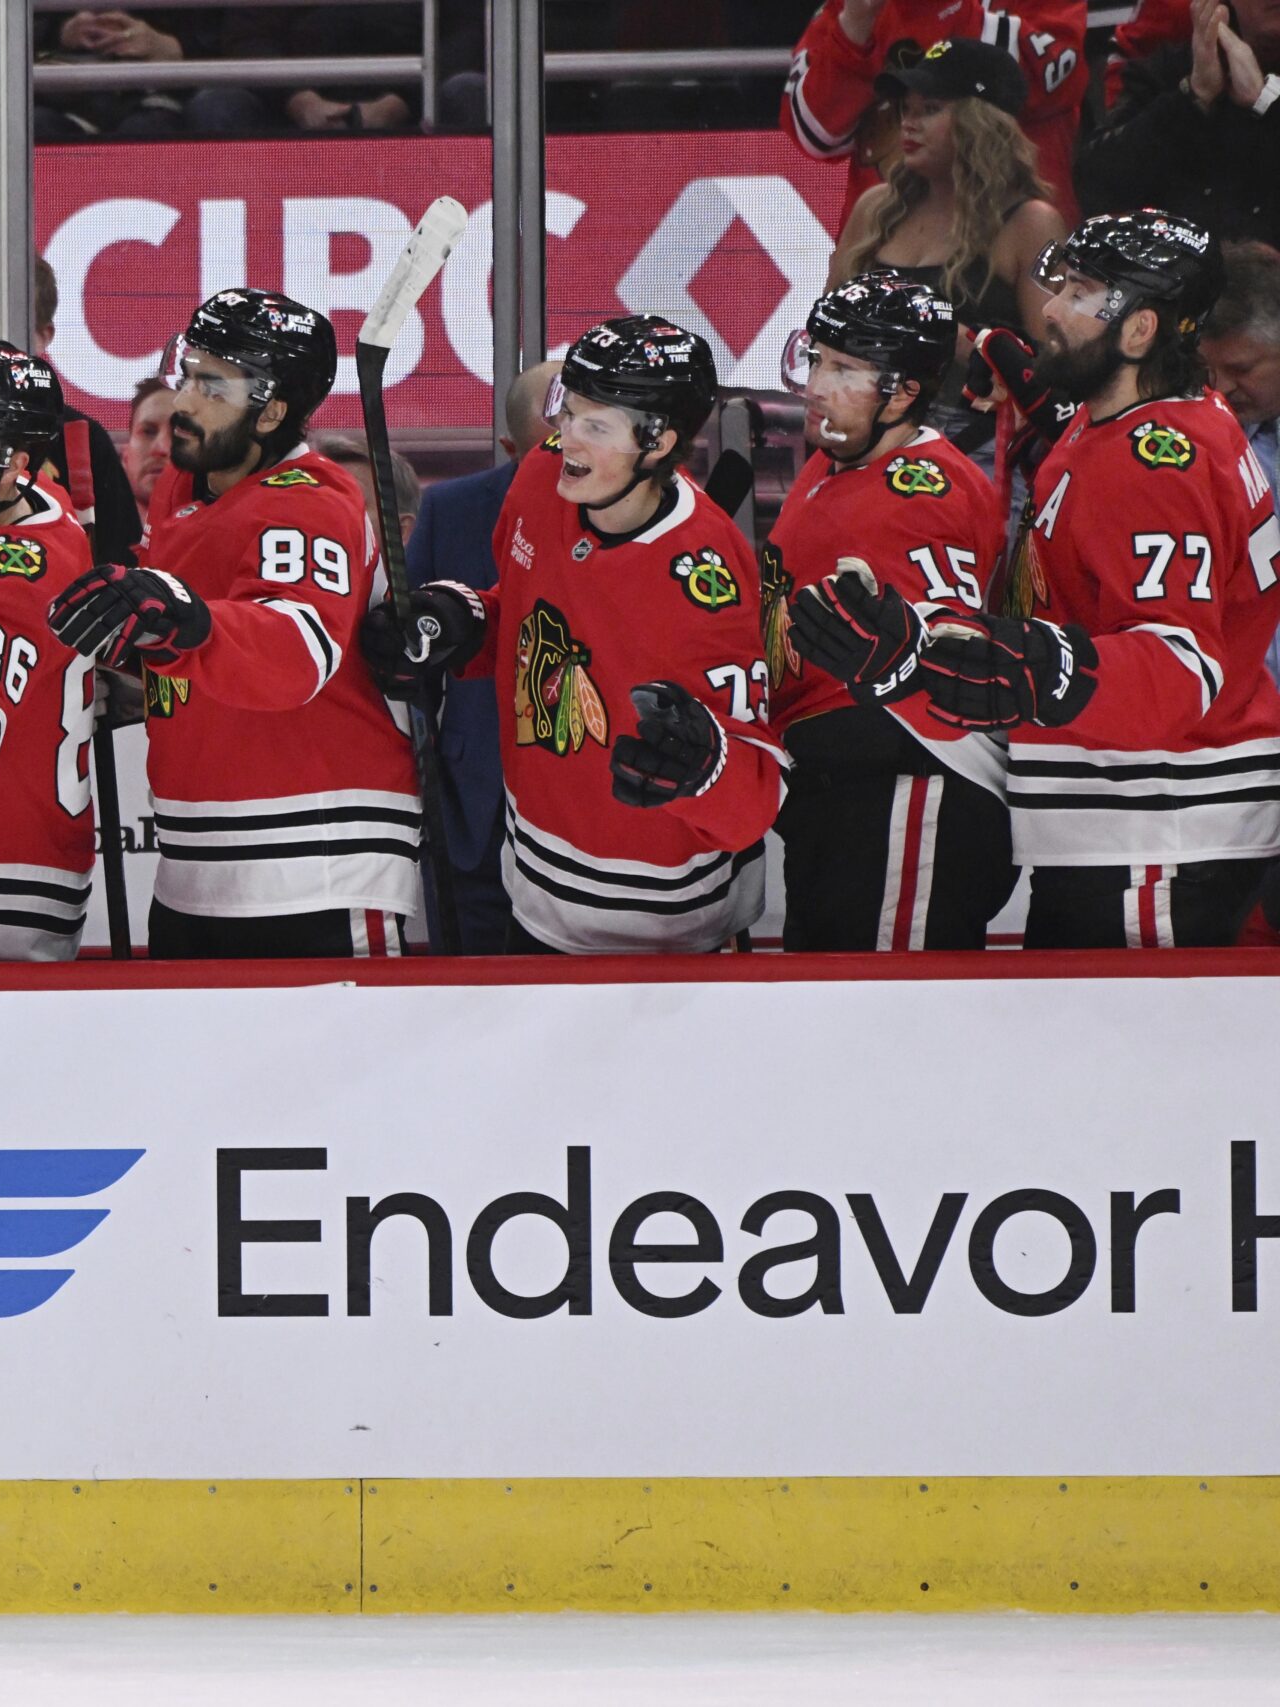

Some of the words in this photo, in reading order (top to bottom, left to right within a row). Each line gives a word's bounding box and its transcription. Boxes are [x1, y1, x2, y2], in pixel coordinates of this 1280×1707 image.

[40, 190, 587, 400] CIBC
[33, 378, 51, 388] TIRE
[1035, 471, 1071, 540] A
[261, 529, 351, 596] 89
[909, 546, 983, 610] 15
[1134, 533, 1212, 600] 77
[216, 1145, 1181, 1319] Endeavor
